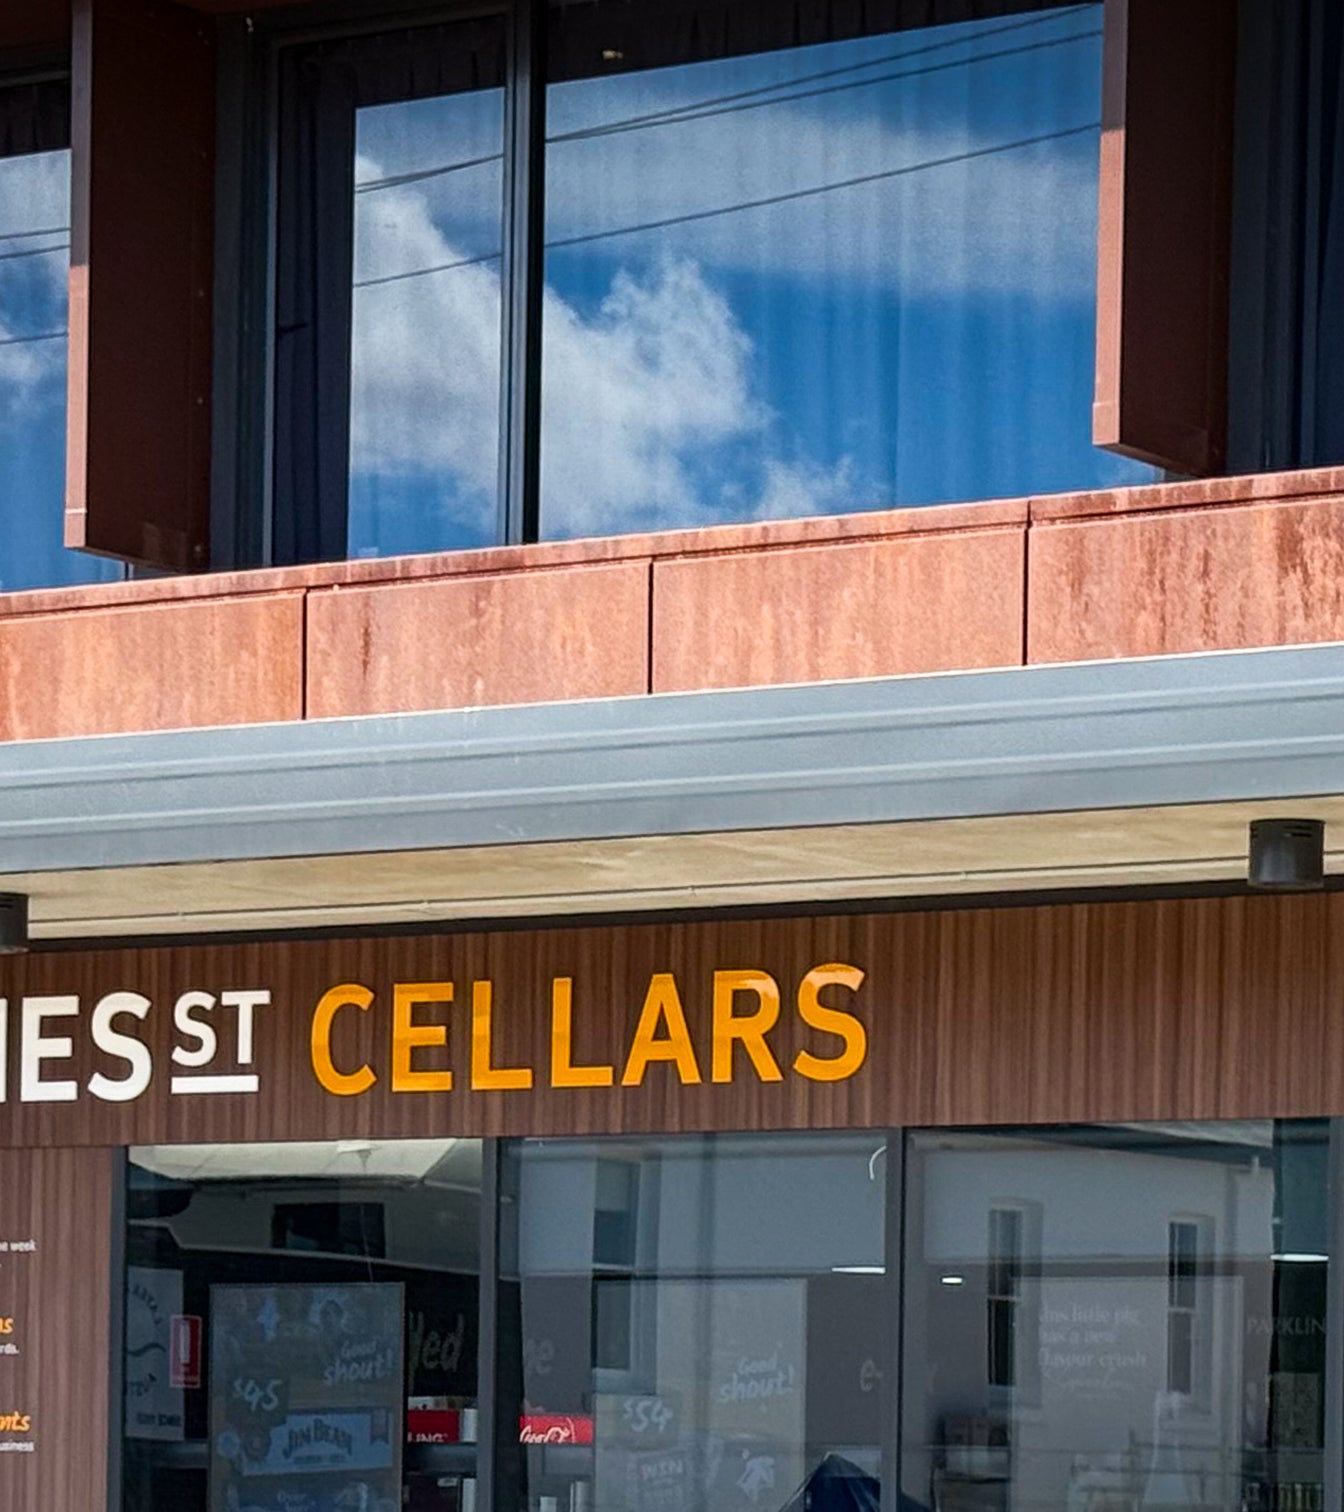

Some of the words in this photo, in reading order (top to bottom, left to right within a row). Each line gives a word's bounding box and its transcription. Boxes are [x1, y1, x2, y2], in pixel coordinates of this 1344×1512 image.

[171, 990, 271, 1095] ST
[311, 964, 868, 1096] CELLARS
[11, 1240, 36, 1251] week
